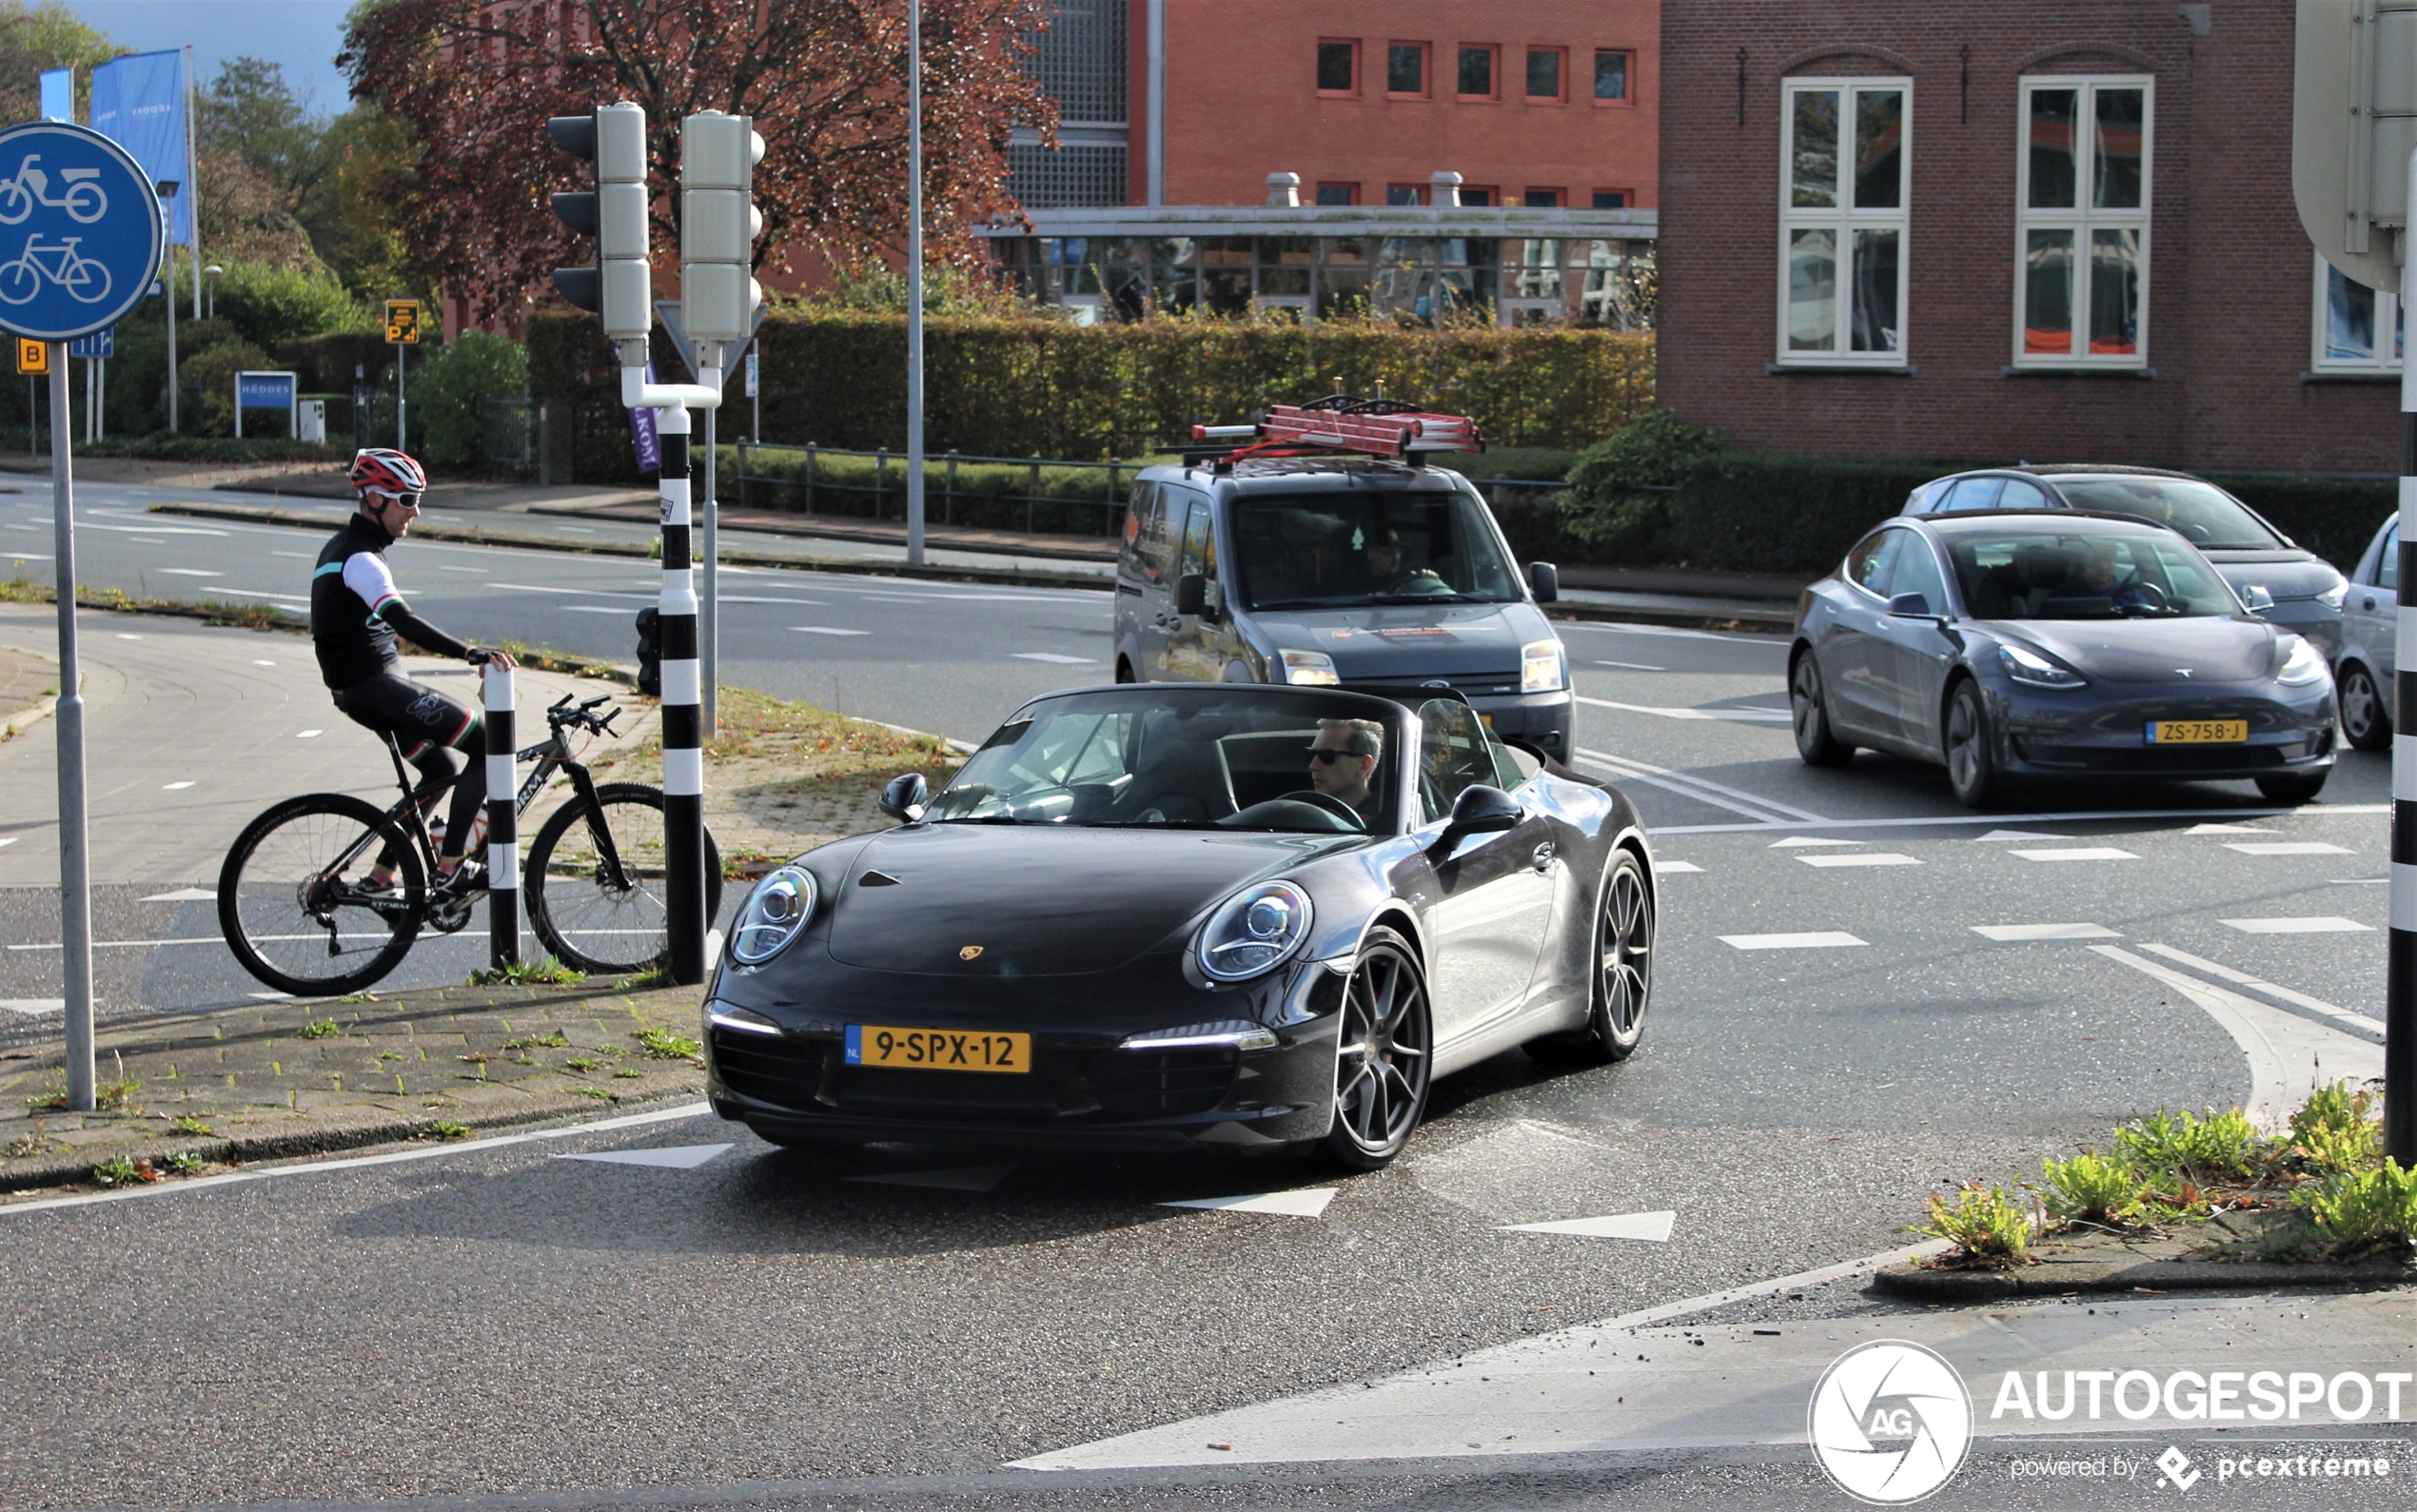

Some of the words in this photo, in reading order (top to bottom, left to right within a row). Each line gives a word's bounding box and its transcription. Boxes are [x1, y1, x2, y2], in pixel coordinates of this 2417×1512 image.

[388, 325, 402, 341] P
[27, 346, 39, 362] B
[2164, 723, 2240, 740] ZS-758-J
[848, 1049, 860, 1058] NL
[876, 1031, 1013, 1066] 9-SPX-12
